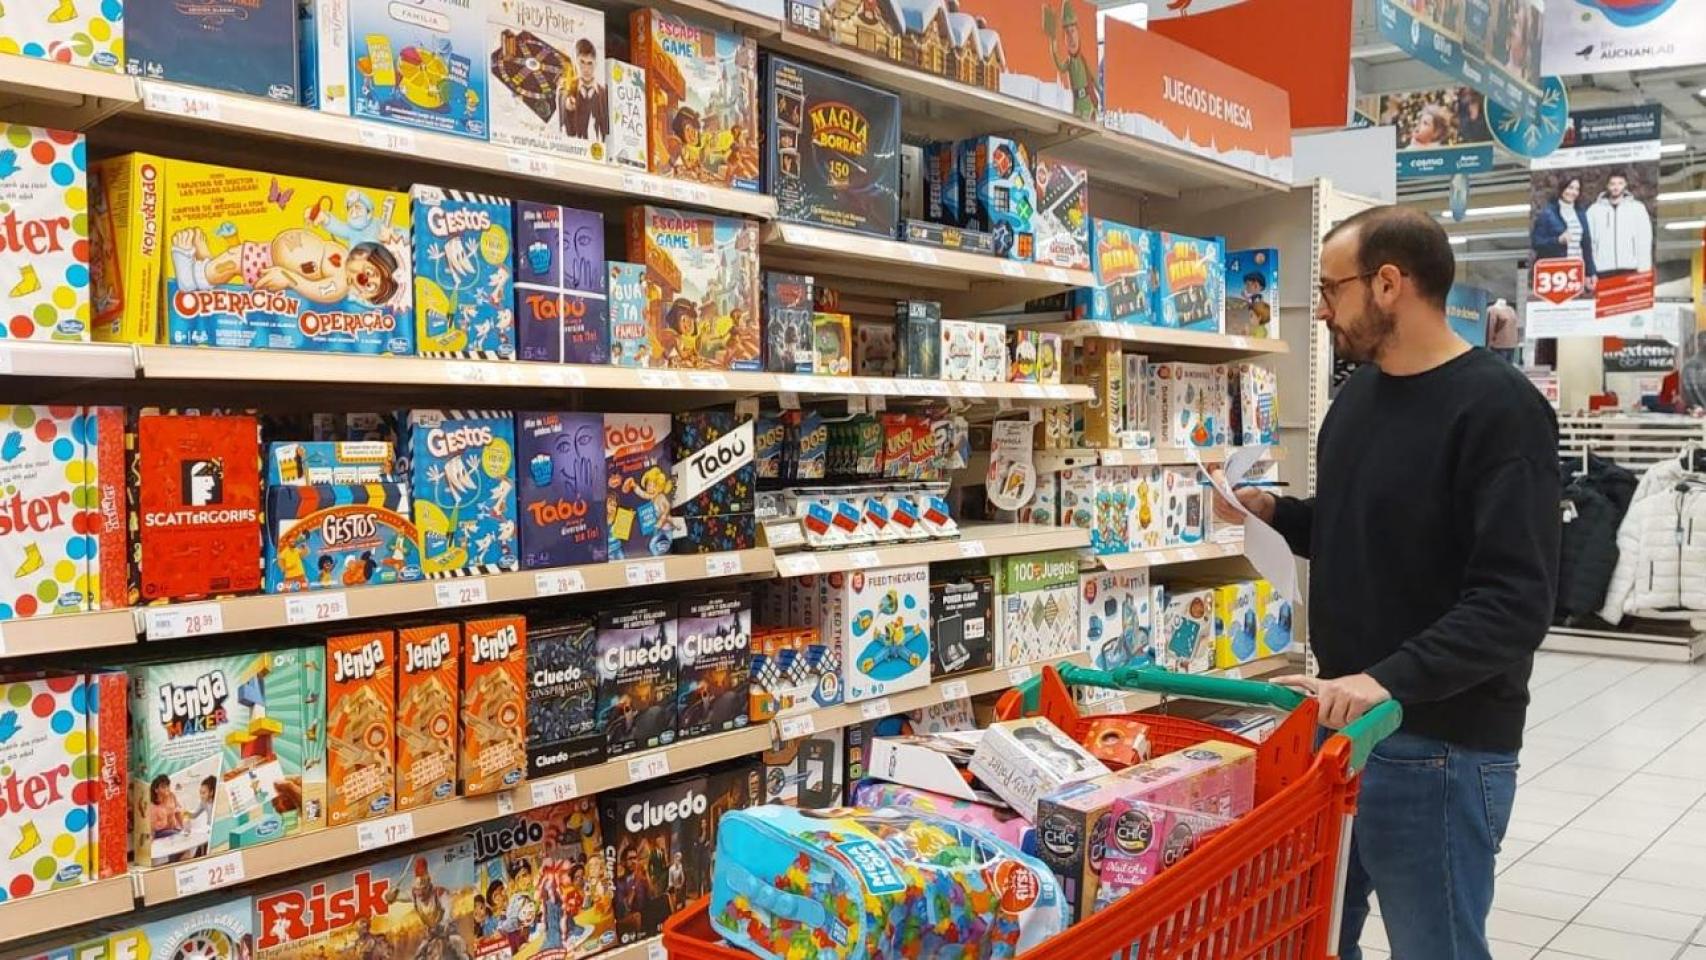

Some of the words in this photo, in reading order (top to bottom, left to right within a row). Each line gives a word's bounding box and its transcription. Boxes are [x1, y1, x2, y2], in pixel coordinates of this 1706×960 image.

[657, 20, 701, 43] ESCAPE
[662, 38, 693, 57] GAME
[1162, 75, 1209, 117] JUEGOS
[1208, 93, 1224, 119] DE
[1224, 98, 1253, 131] MESA
[810, 106, 870, 143] MAGIA
[965, 150, 977, 214] SPEEDCUBE
[428, 207, 492, 237] Gestos
[652, 216, 698, 234] ESCAPE
[656, 234, 690, 249] GAME
[1231, 260, 1240, 272] 4
[173, 289, 300, 322] OPERACIÓN
[299, 306, 396, 337] OPERAÇÃO
[525, 296, 588, 321] Tabú
[427, 425, 494, 458] Gestos
[757, 425, 784, 450] DOS
[800, 425, 828, 452] DOS
[887, 427, 913, 454] UNO
[912, 433, 936, 457] UNO
[690, 433, 746, 480] Tabú
[145, 509, 257, 527] SCATTERGORIES
[527, 496, 589, 527] Tabú
[322, 513, 378, 545] GESTOS
[1014, 563, 1034, 584] 100
[1041, 561, 1075, 580] Juegos
[405, 632, 451, 674] Jenga
[471, 624, 518, 664] Jenga
[604, 639, 674, 672] Cluedo
[683, 627, 748, 658] Cluedo
[333, 639, 385, 683] Jenga
[533, 664, 581, 688] Cluedo
[158, 669, 229, 725] Jenga
[166, 705, 229, 741] MAKER
[534, 750, 569, 768] Cluedo
[625, 790, 707, 834] Cluedo
[472, 819, 544, 862] luedo
[1044, 829, 1076, 845] CHIC
[1117, 827, 1149, 842] CHIC
[257, 868, 390, 952] Risk
